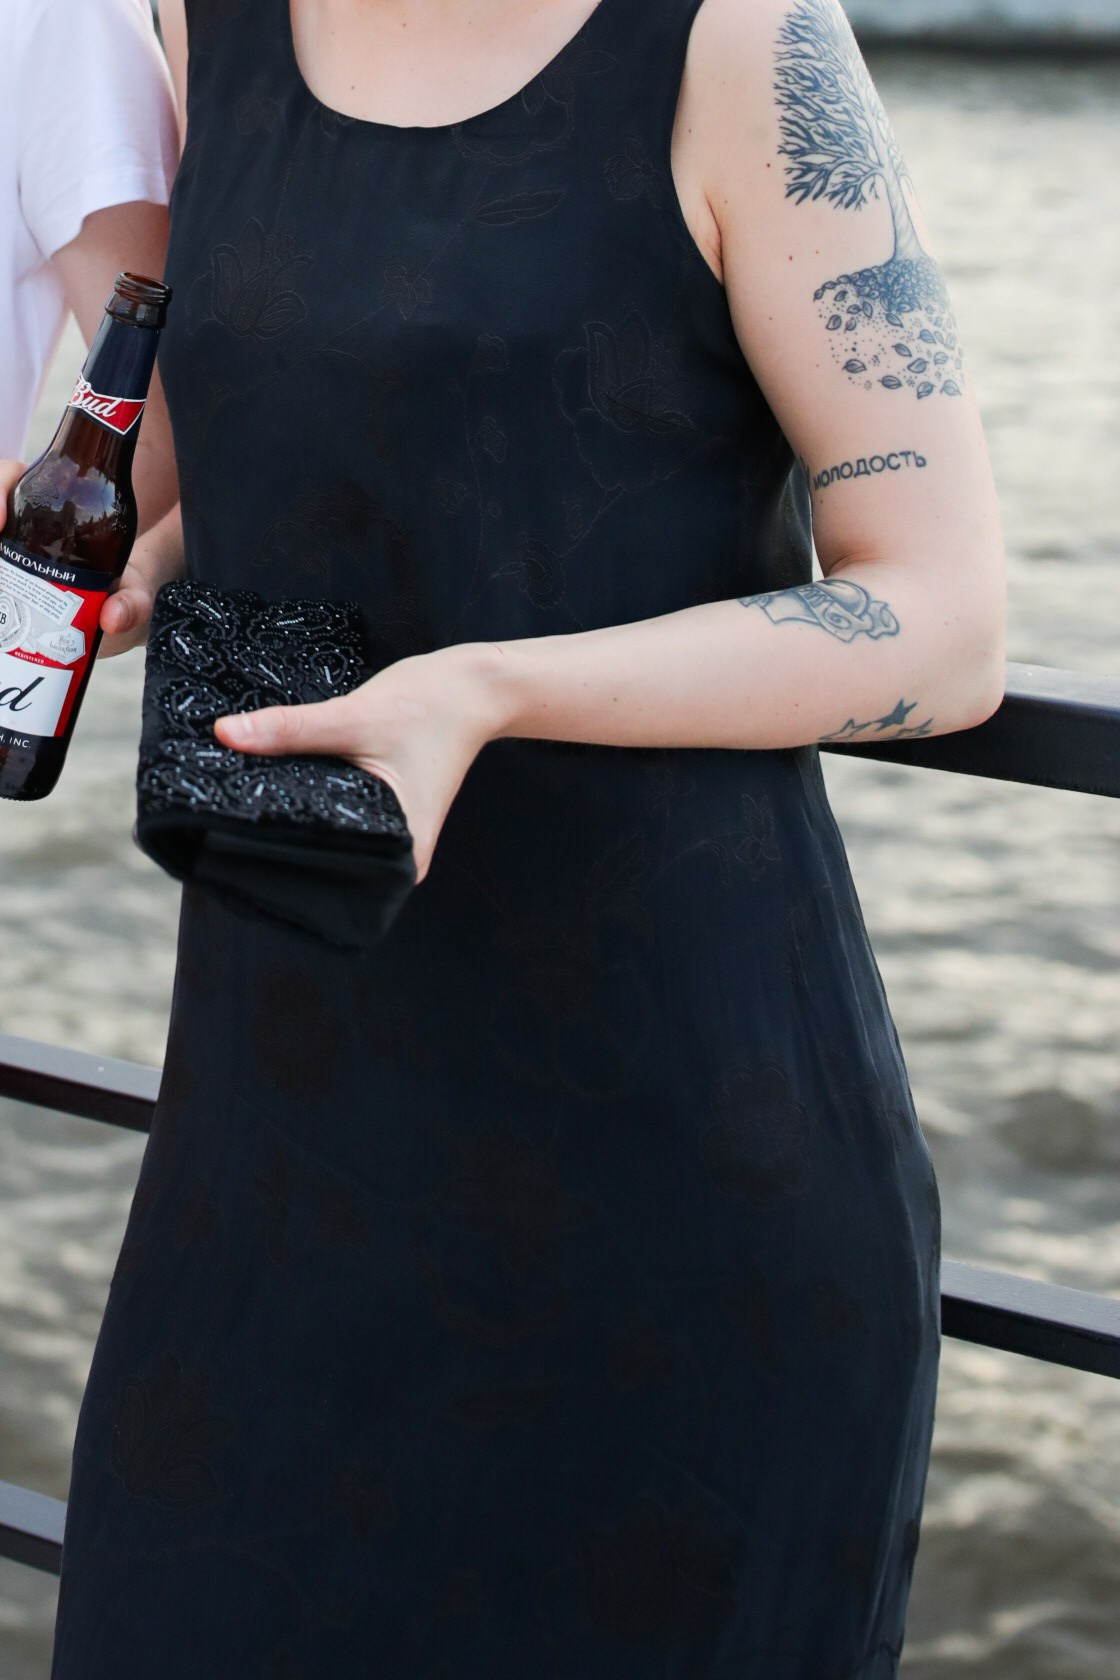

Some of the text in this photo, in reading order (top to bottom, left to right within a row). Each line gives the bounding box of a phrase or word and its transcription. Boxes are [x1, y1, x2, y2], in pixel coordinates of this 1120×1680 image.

[70, 381, 117, 418] Bud
[14, 651, 45, 665] REGISTERED
[9, 736, 32, 749] INC.
